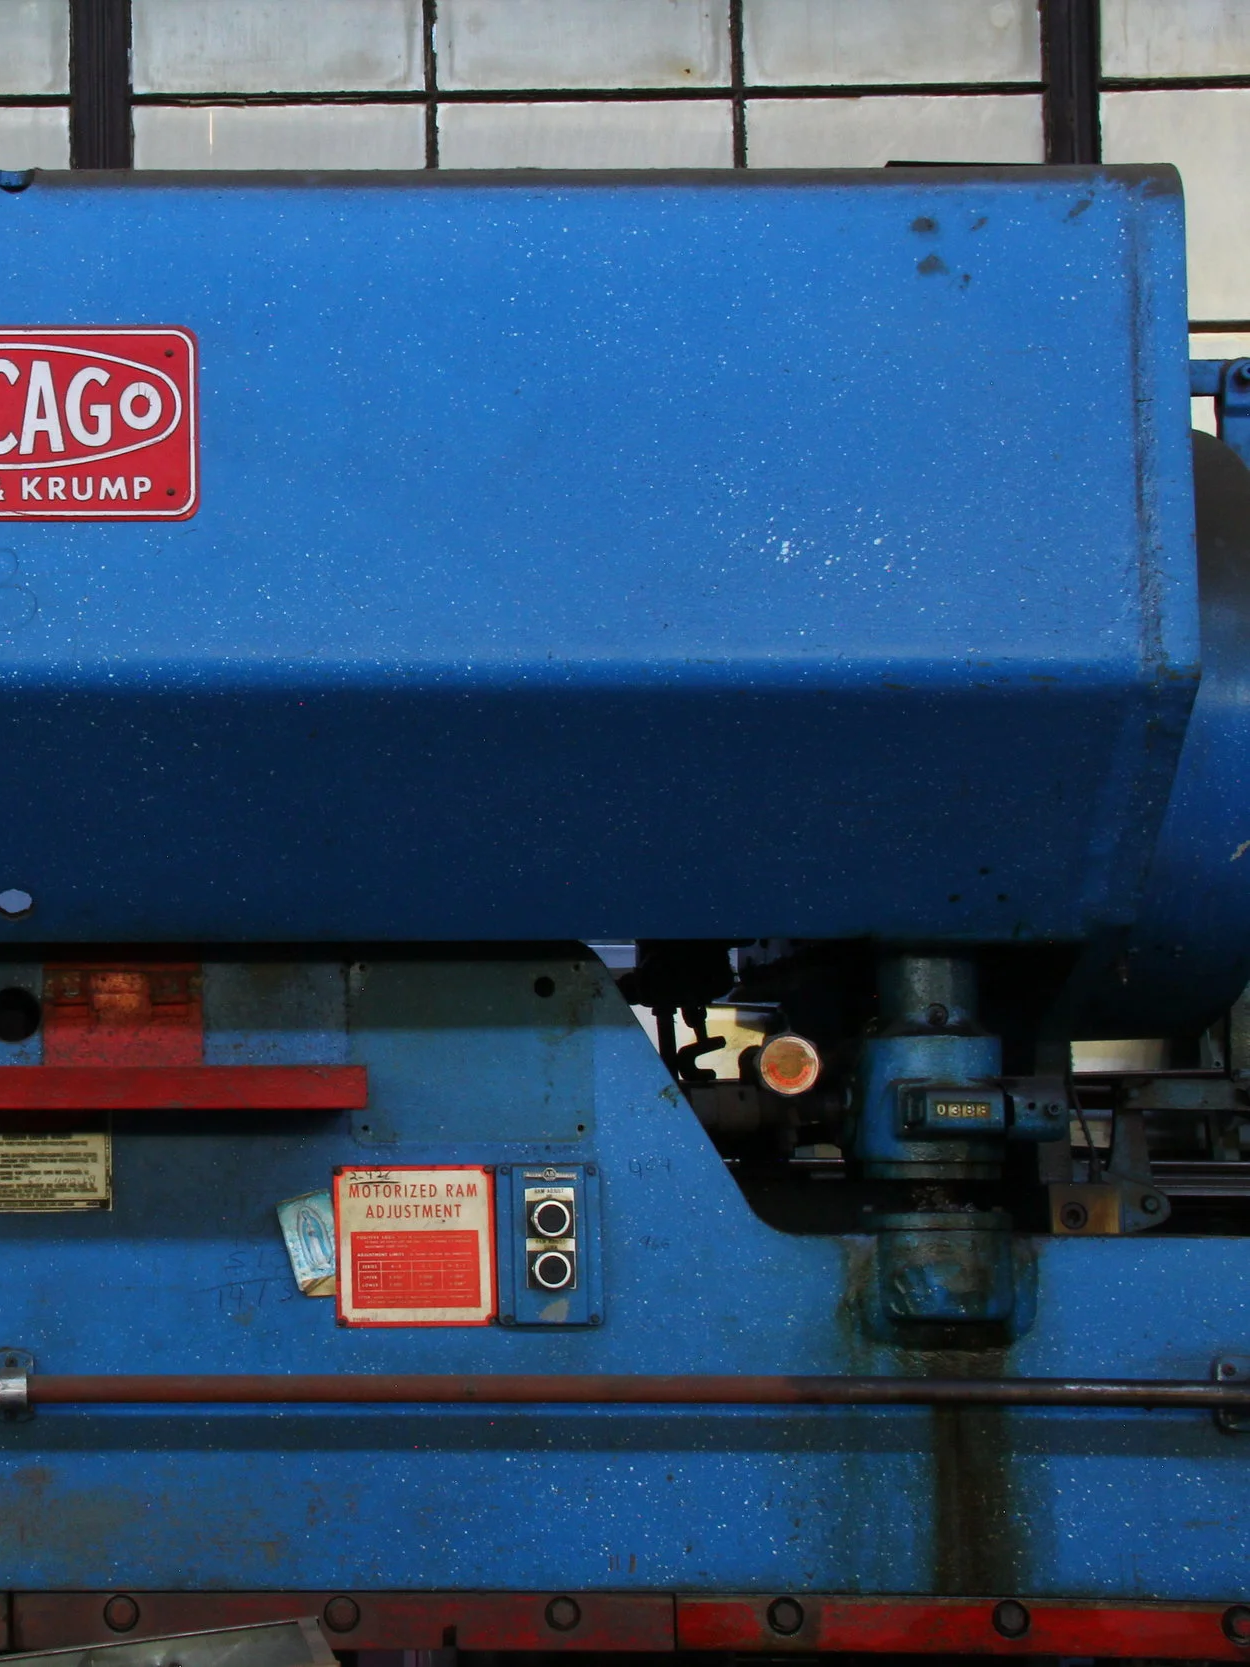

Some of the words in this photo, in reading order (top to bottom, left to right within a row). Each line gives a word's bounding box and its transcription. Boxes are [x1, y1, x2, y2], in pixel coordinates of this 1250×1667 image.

[21, 476, 152, 501] KRUMP
[349, 1184, 438, 1198] MOTORIZED
[446, 1183, 478, 1198] RAM
[365, 1204, 463, 1219] ADJUSTMENT
